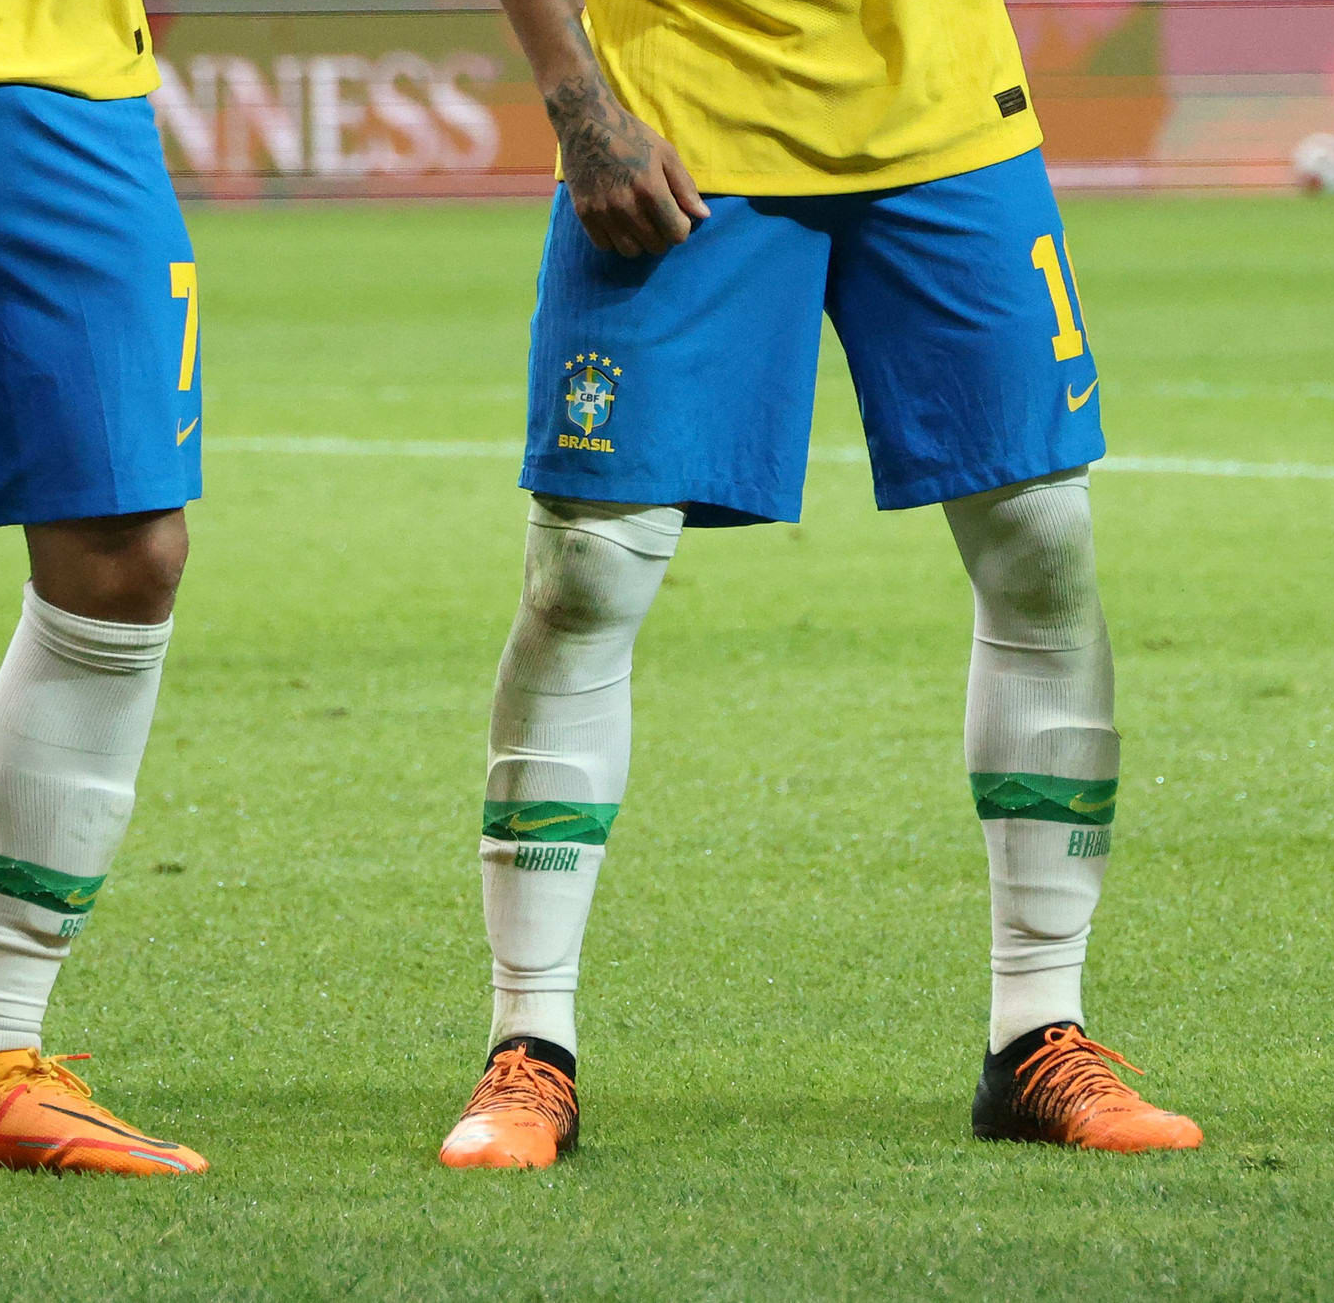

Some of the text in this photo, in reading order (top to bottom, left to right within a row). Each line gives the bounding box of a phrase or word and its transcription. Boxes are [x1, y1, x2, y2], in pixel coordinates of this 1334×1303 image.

[169, 262, 198, 391] 7
[1031, 232, 1089, 362] 1
[580, 393, 600, 402] CBF
[558, 434, 615, 453] BRASIL
